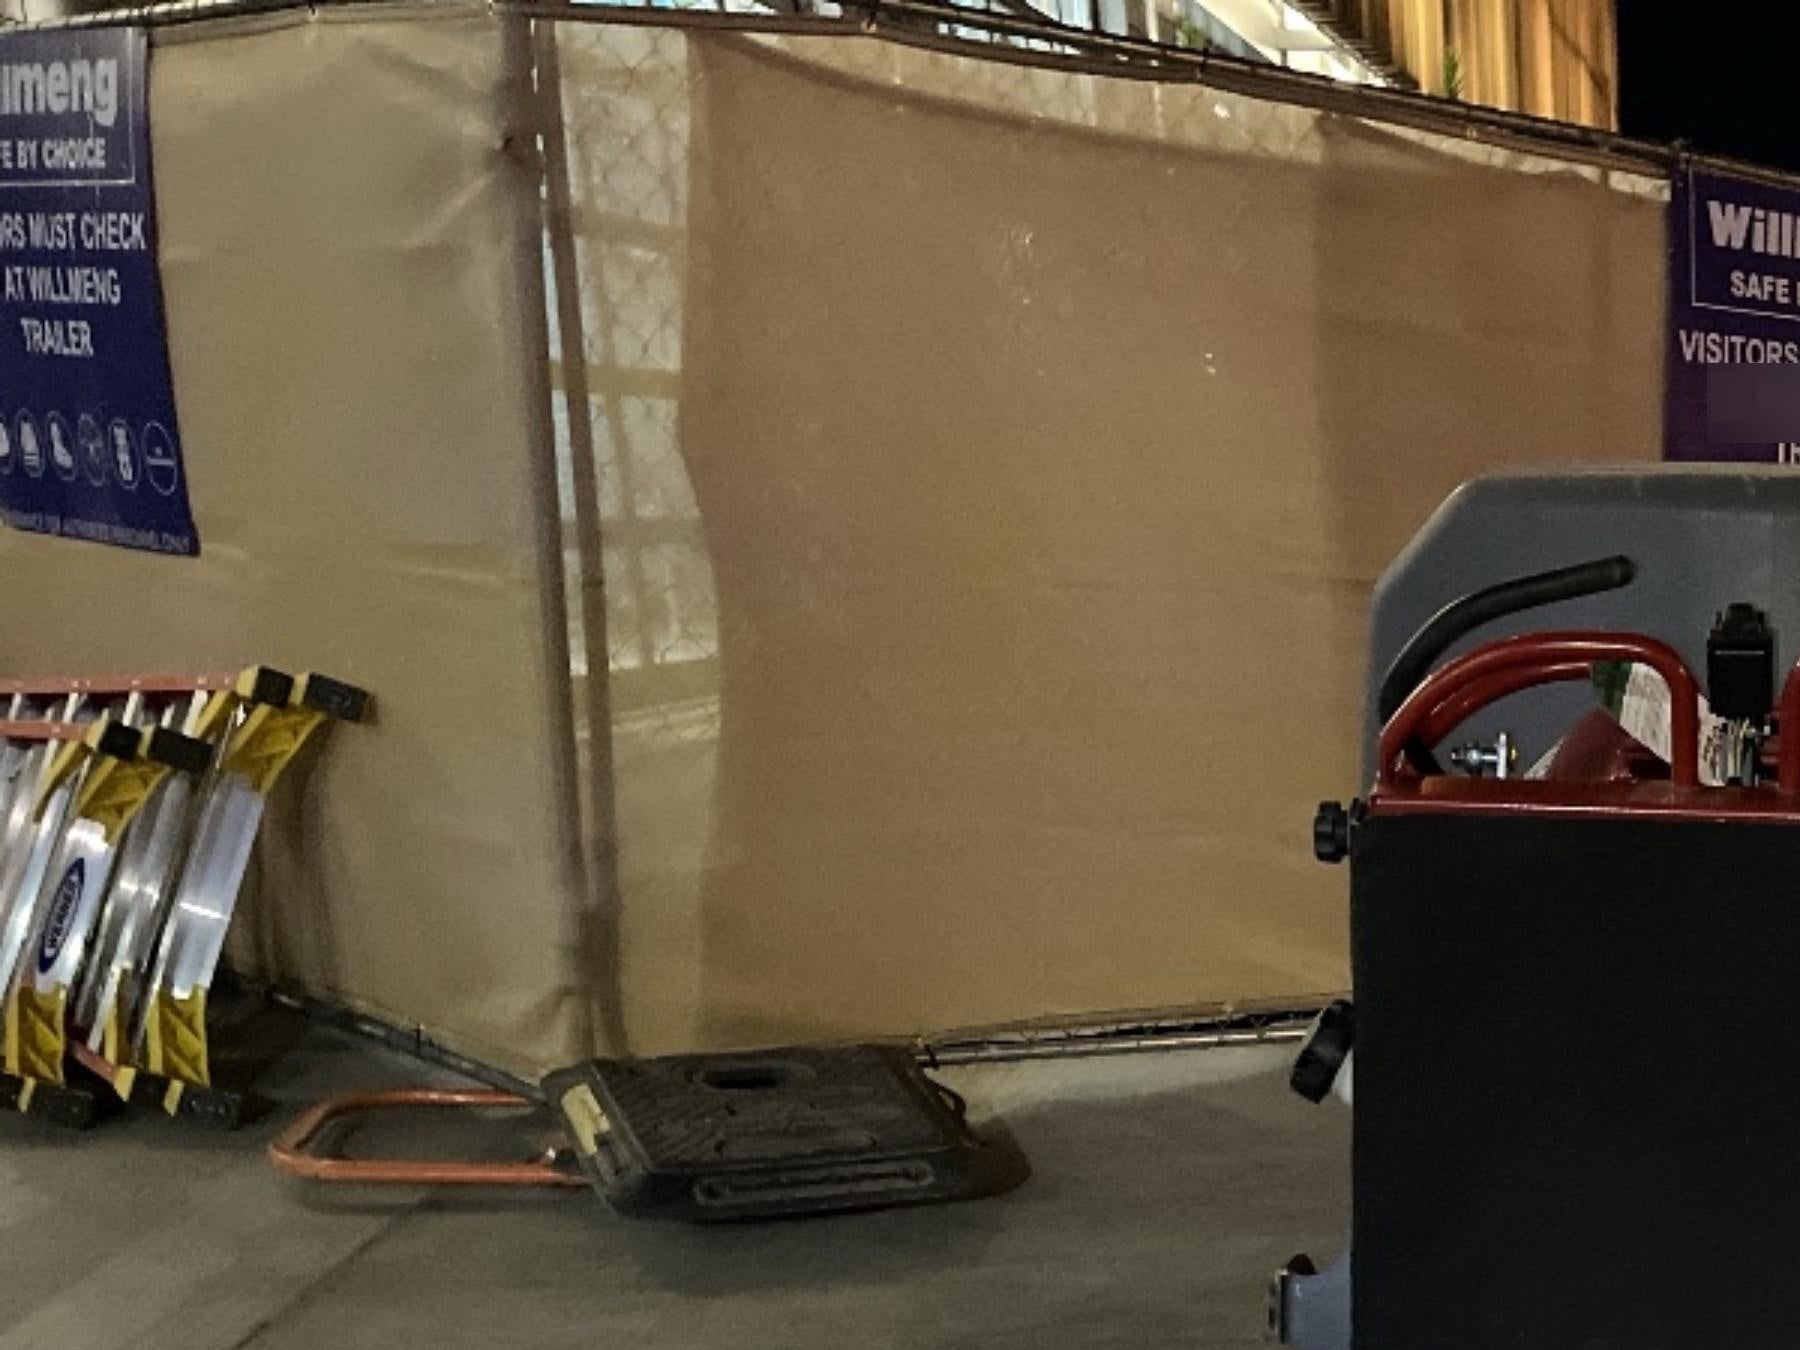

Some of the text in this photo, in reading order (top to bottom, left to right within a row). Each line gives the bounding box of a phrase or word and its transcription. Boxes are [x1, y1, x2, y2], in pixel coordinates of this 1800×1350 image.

[17, 138, 37, 169] BY
[42, 137, 106, 169] CHOICE
[29, 212, 77, 249] MUST
[80, 212, 146, 250] CHECK
[4, 266, 121, 305] AT WILLMENG
[1730, 269, 1789, 304] SAFE
[20, 317, 94, 356] TRAILER
[1679, 329, 1800, 364] VISITORS
